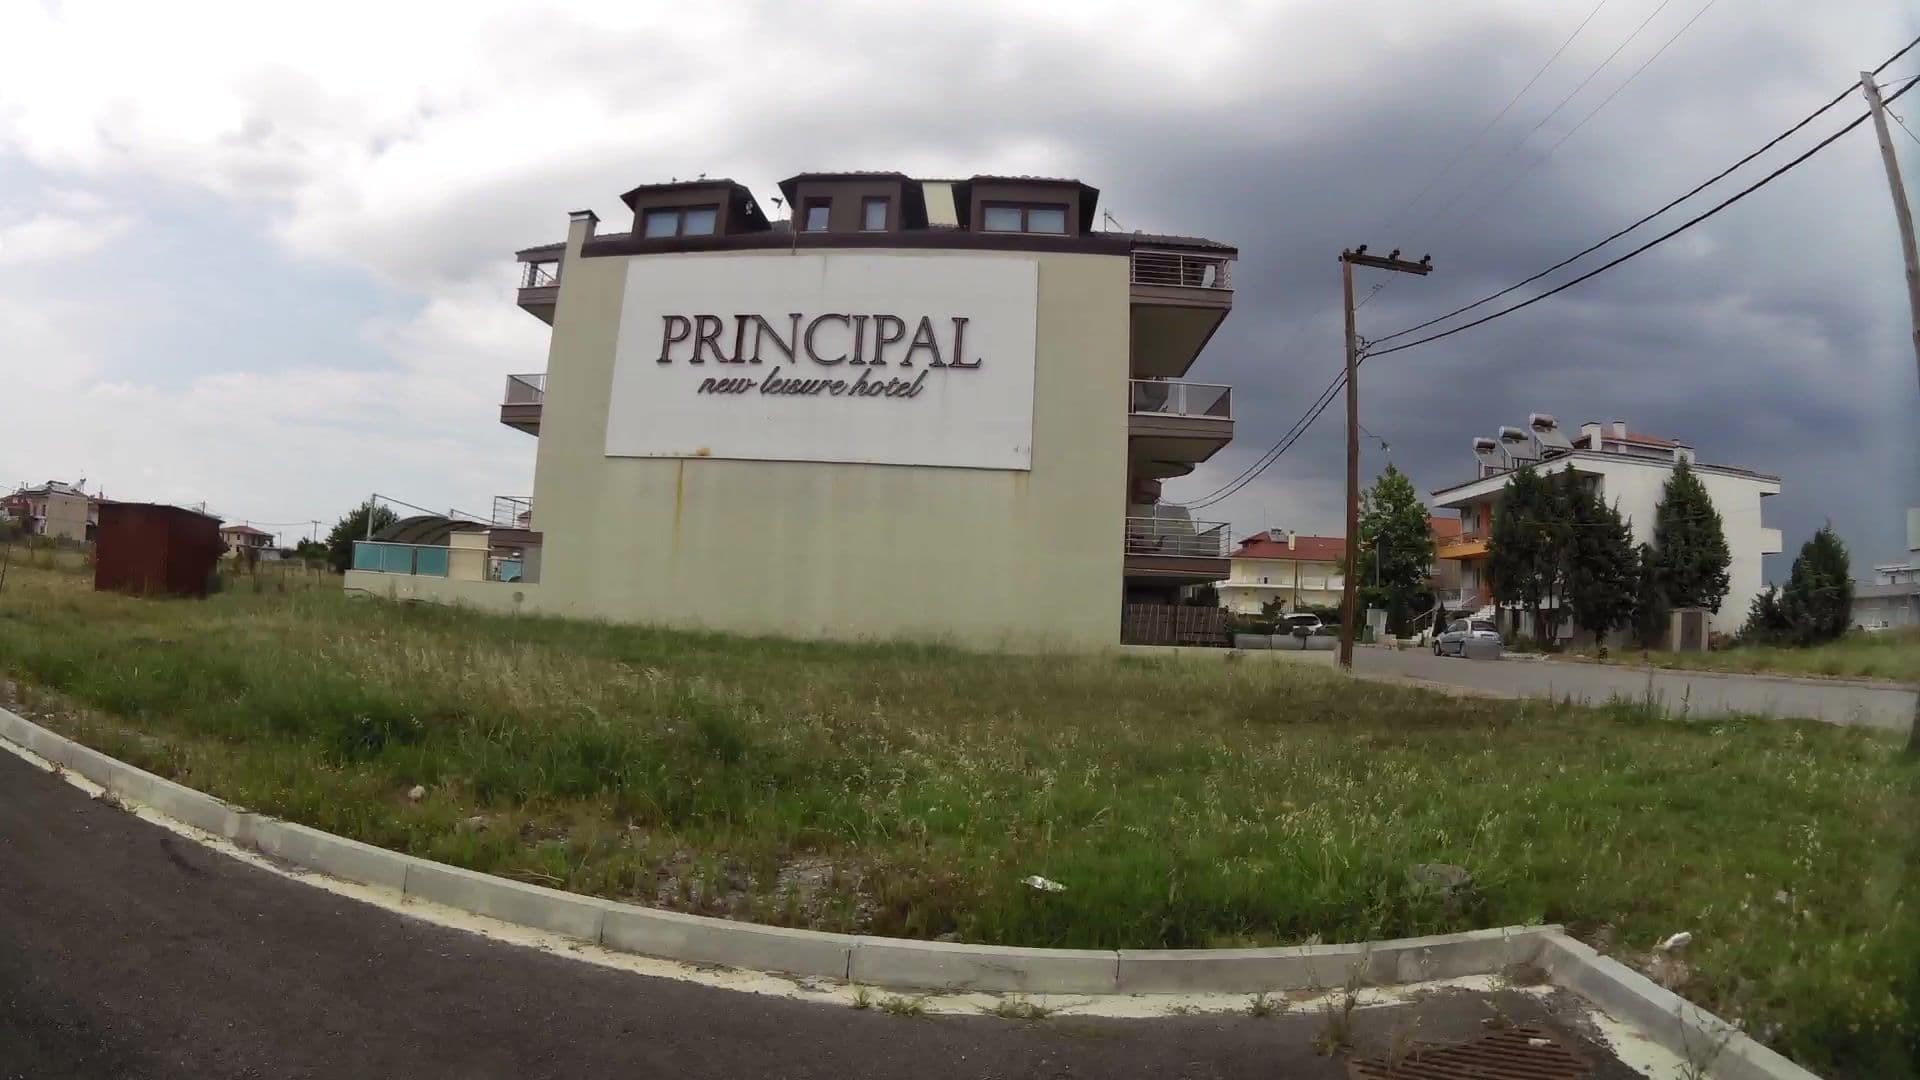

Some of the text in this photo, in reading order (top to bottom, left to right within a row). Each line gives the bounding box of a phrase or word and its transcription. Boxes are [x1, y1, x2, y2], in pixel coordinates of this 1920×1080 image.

[656, 313, 982, 369] PRINCIPAL
[698, 366, 929, 399] new leisure hotel
